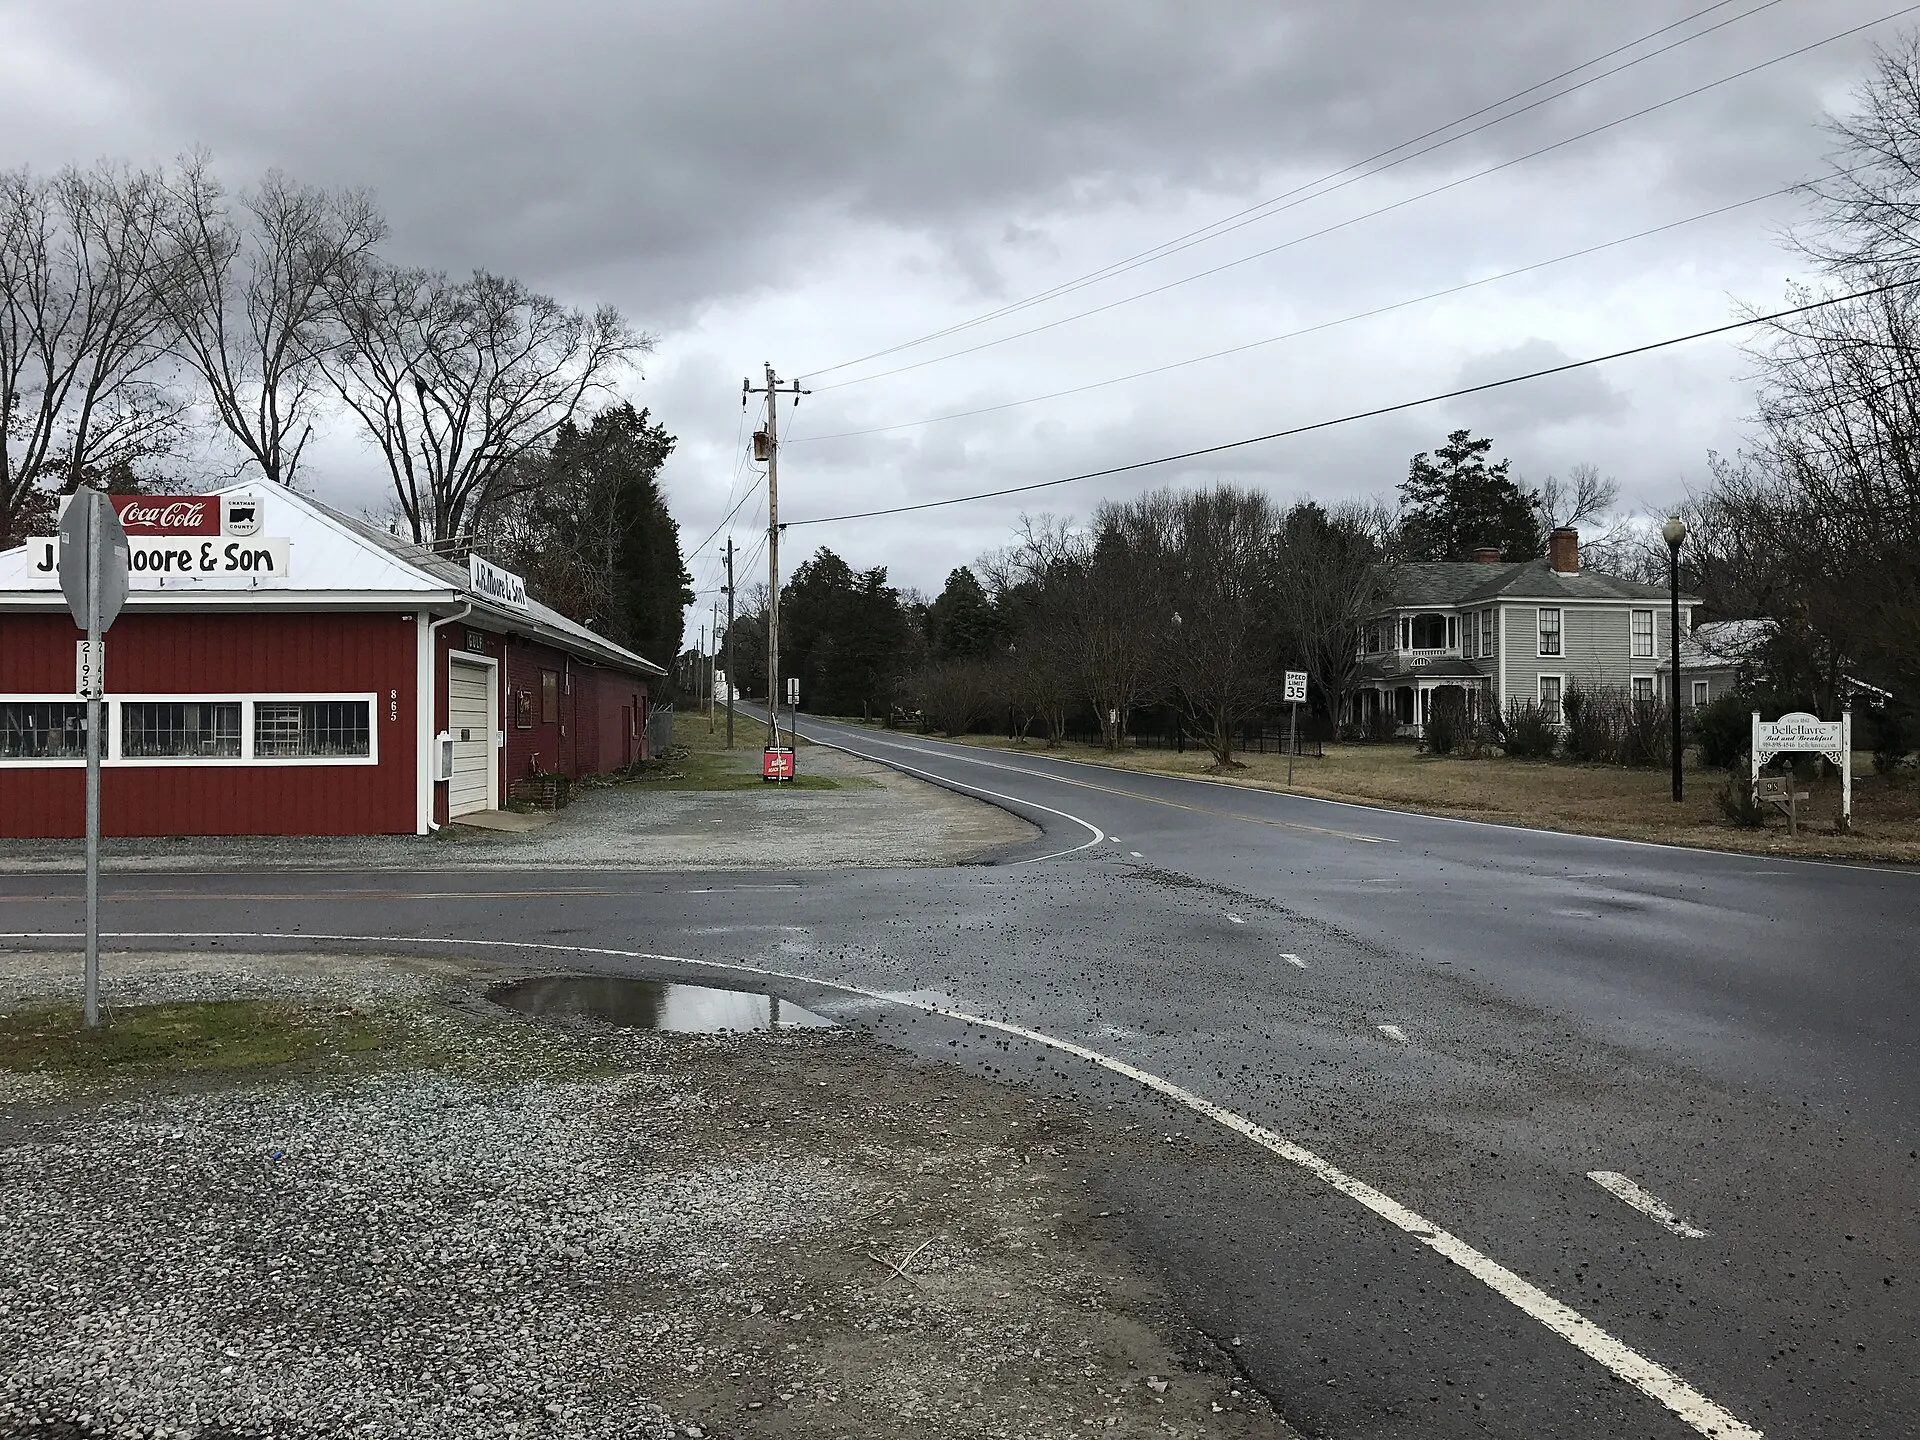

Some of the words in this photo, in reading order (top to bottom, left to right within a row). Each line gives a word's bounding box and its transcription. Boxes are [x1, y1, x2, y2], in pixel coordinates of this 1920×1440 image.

[119, 502, 206, 527] Coca-Cola
[200, 542, 217, 571] &
[225, 543, 274, 571] Son
[505, 573, 512, 602] &
[512, 578, 526, 605] Son
[468, 634, 483, 650] GULF
[1287, 686, 1304, 698] 35
[1772, 725, 1826, 735] BelleHavre
